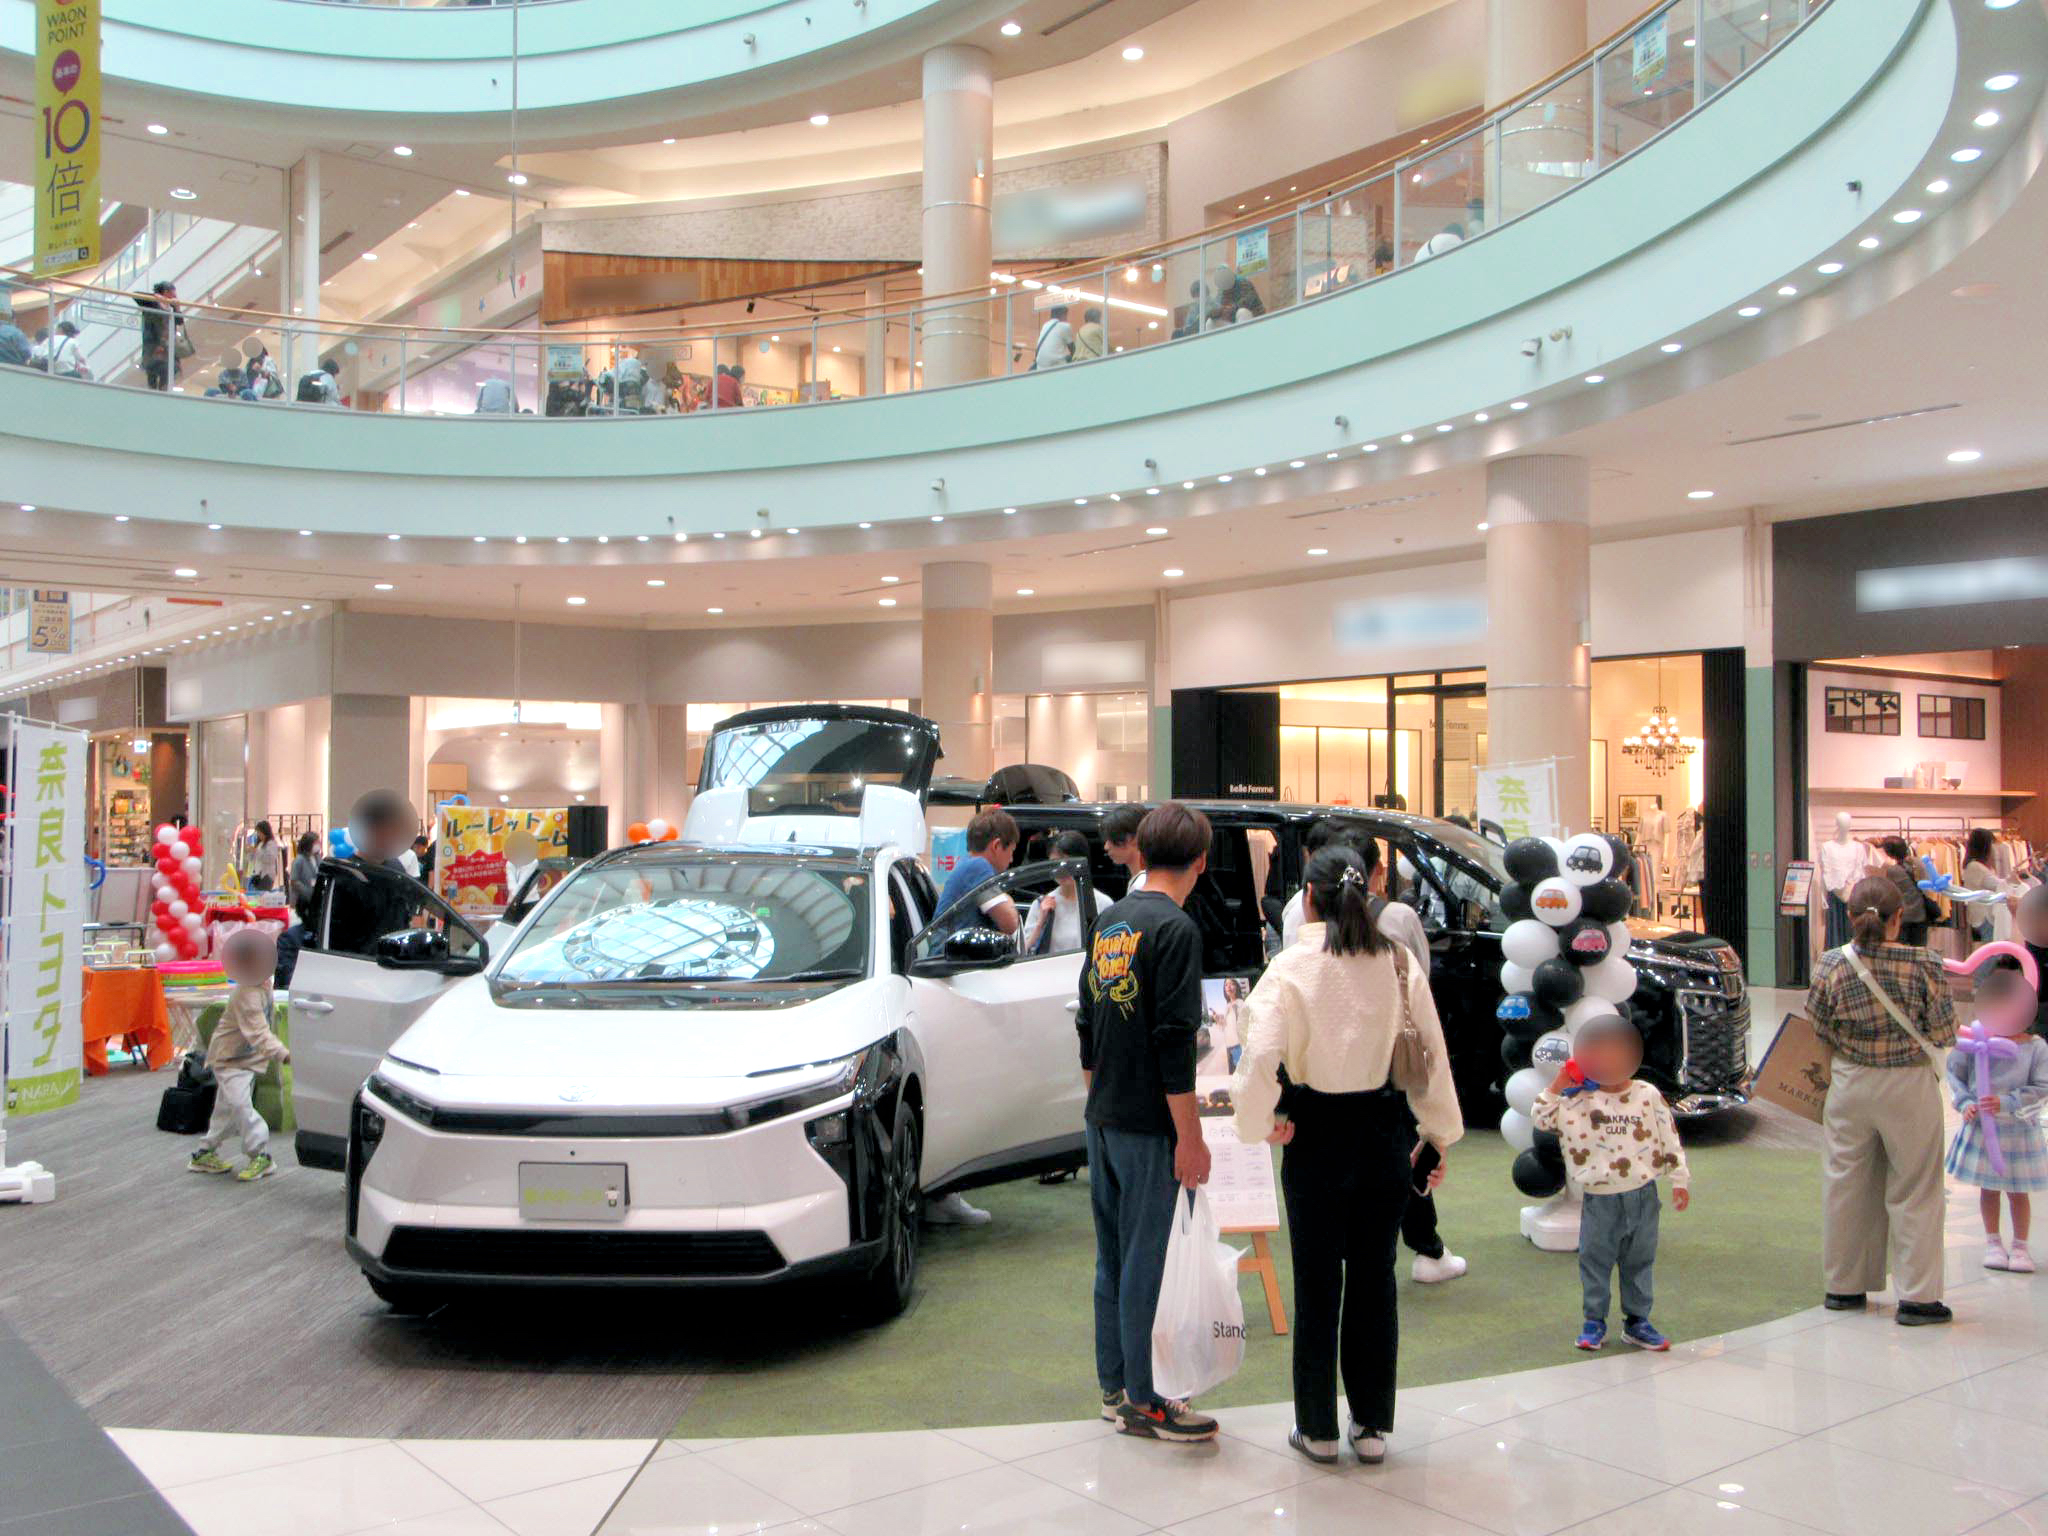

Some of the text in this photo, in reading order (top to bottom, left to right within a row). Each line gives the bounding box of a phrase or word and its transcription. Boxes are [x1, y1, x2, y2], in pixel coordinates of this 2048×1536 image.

[46, 6, 87, 27] WAON
[48, 23, 86, 43] POINT
[43, 99, 90, 159] 10
[46, 161, 85, 218] 倍
[446, 812, 540, 838] ルーレット
[937, 855, 961, 872] トヨ
[33, 743, 67, 1068] 奈良トヨタ
[1605, 1126, 1627, 1135] CLUB
